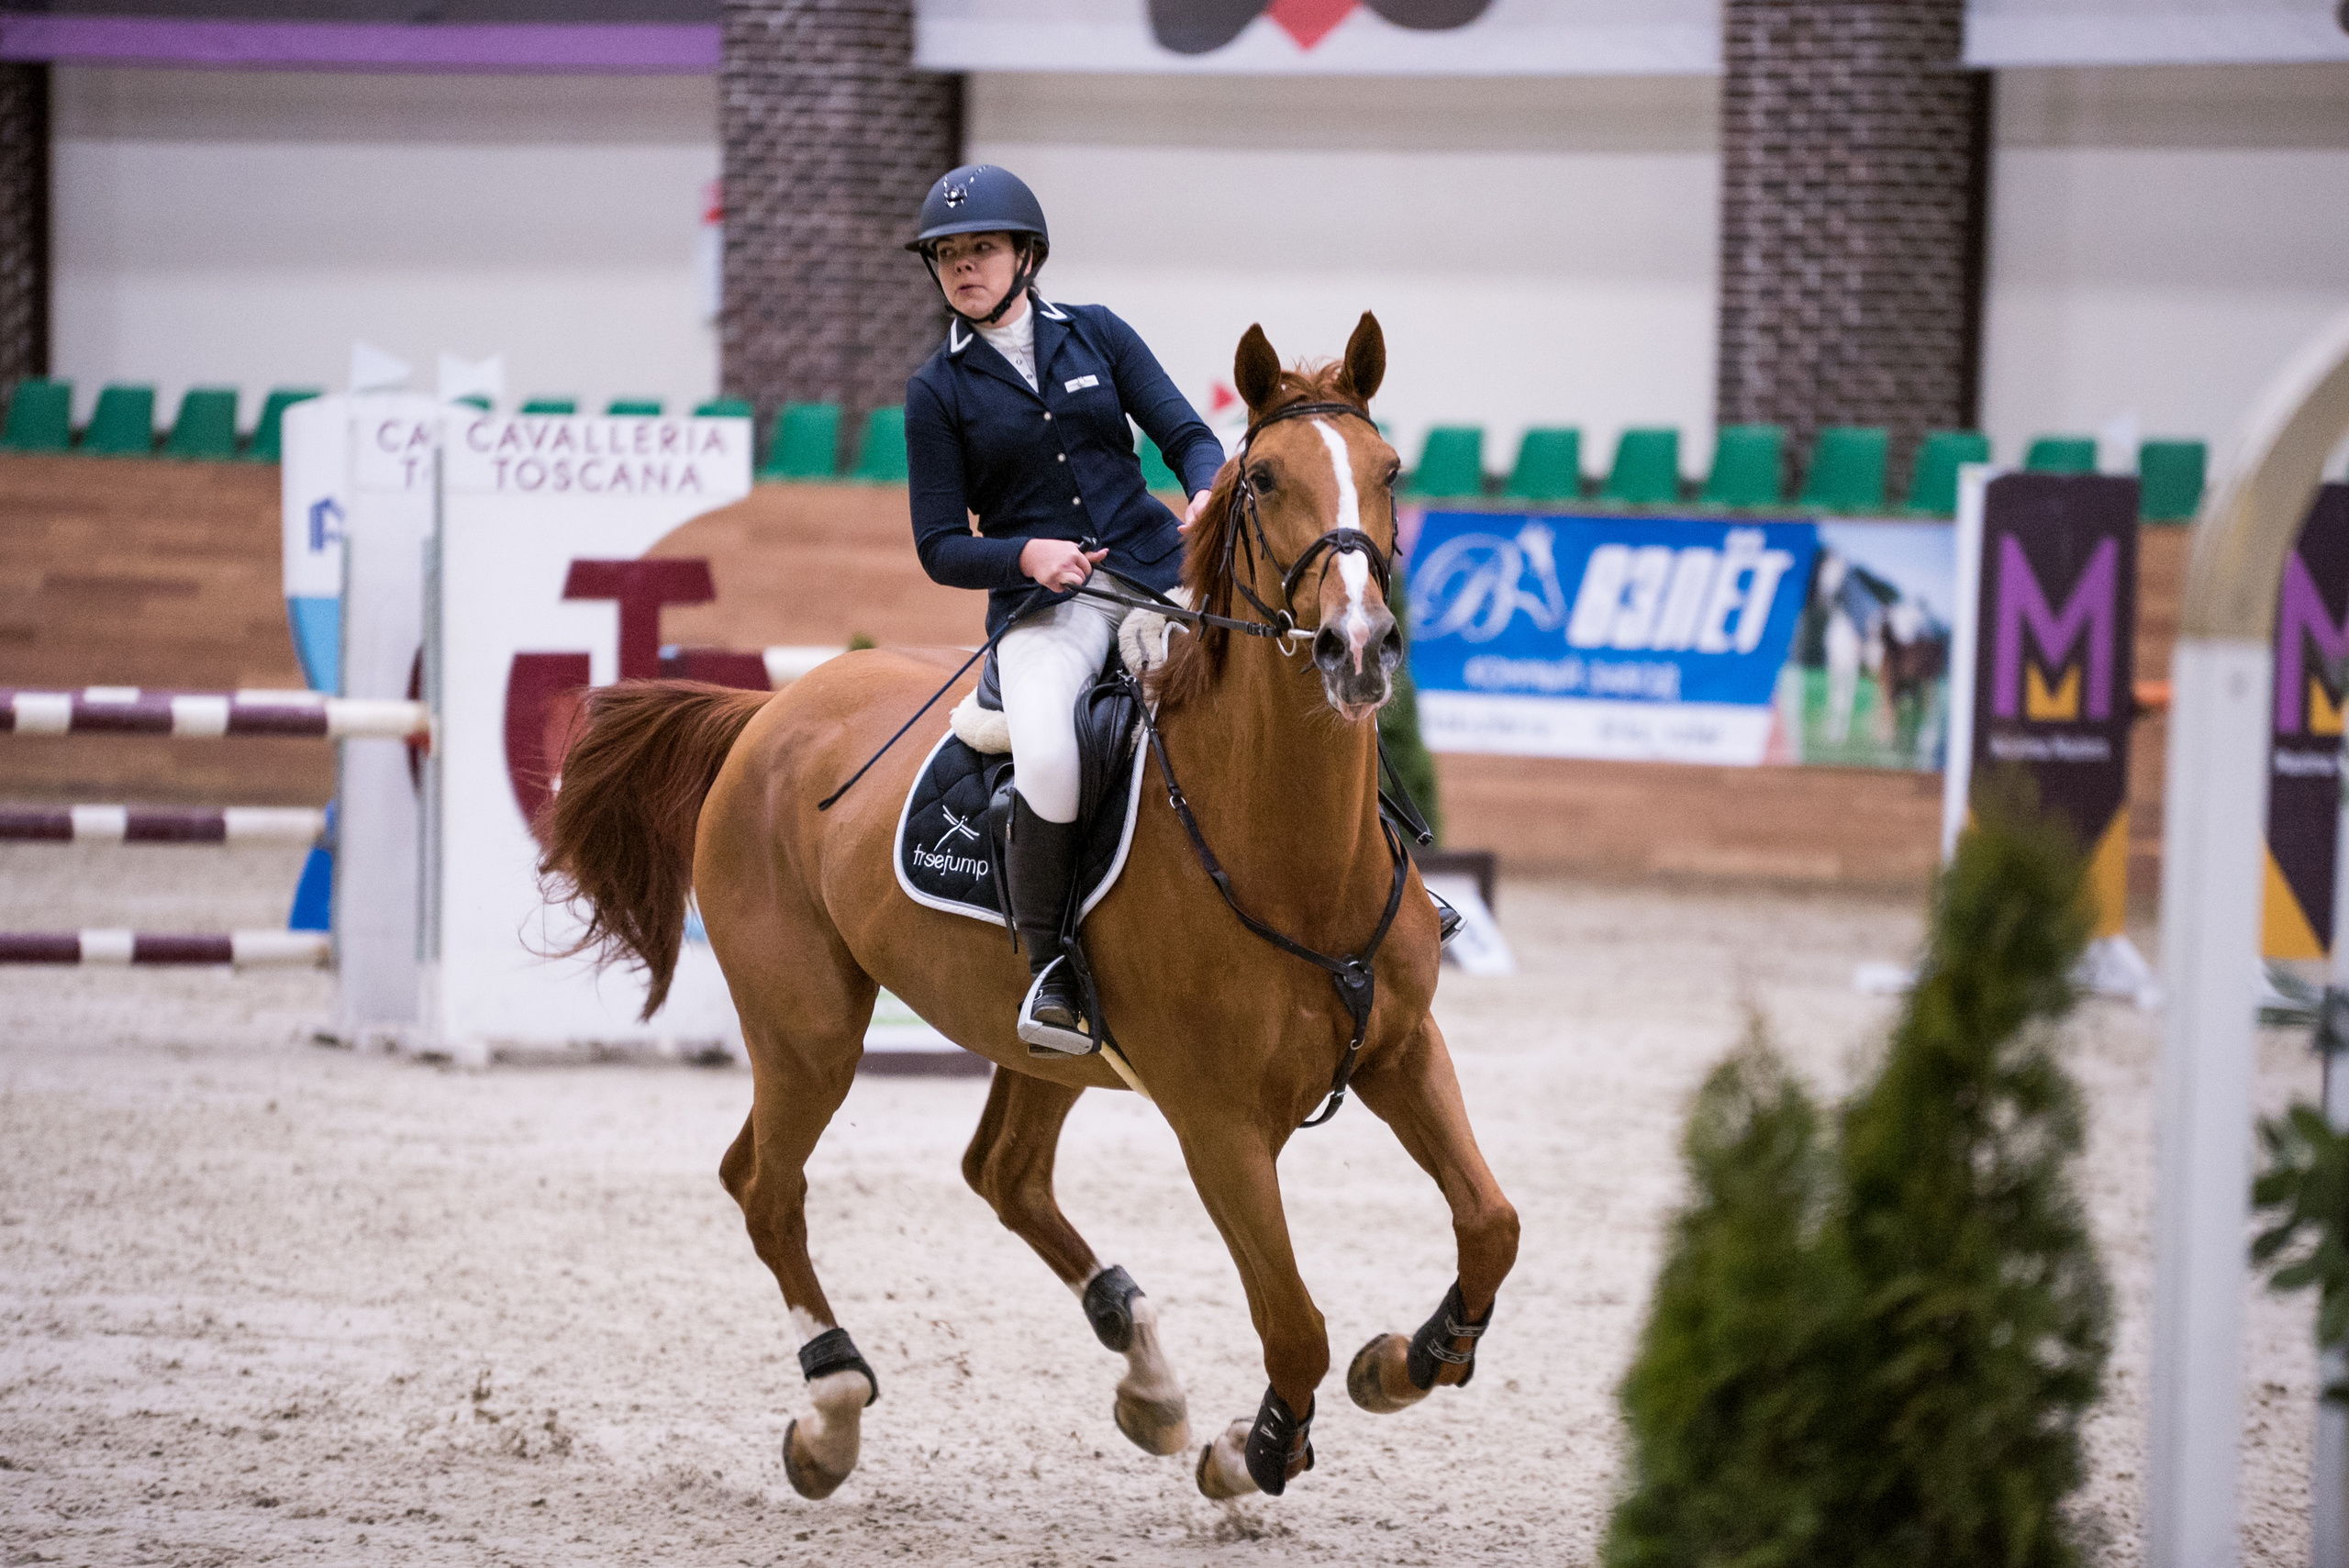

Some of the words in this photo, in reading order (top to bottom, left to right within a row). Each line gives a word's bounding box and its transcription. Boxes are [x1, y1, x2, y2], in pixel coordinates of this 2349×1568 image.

[466, 418, 726, 454] CAVALLERIA
[491, 459, 702, 493] TOSCANA
[913, 843, 989, 881] freejump
